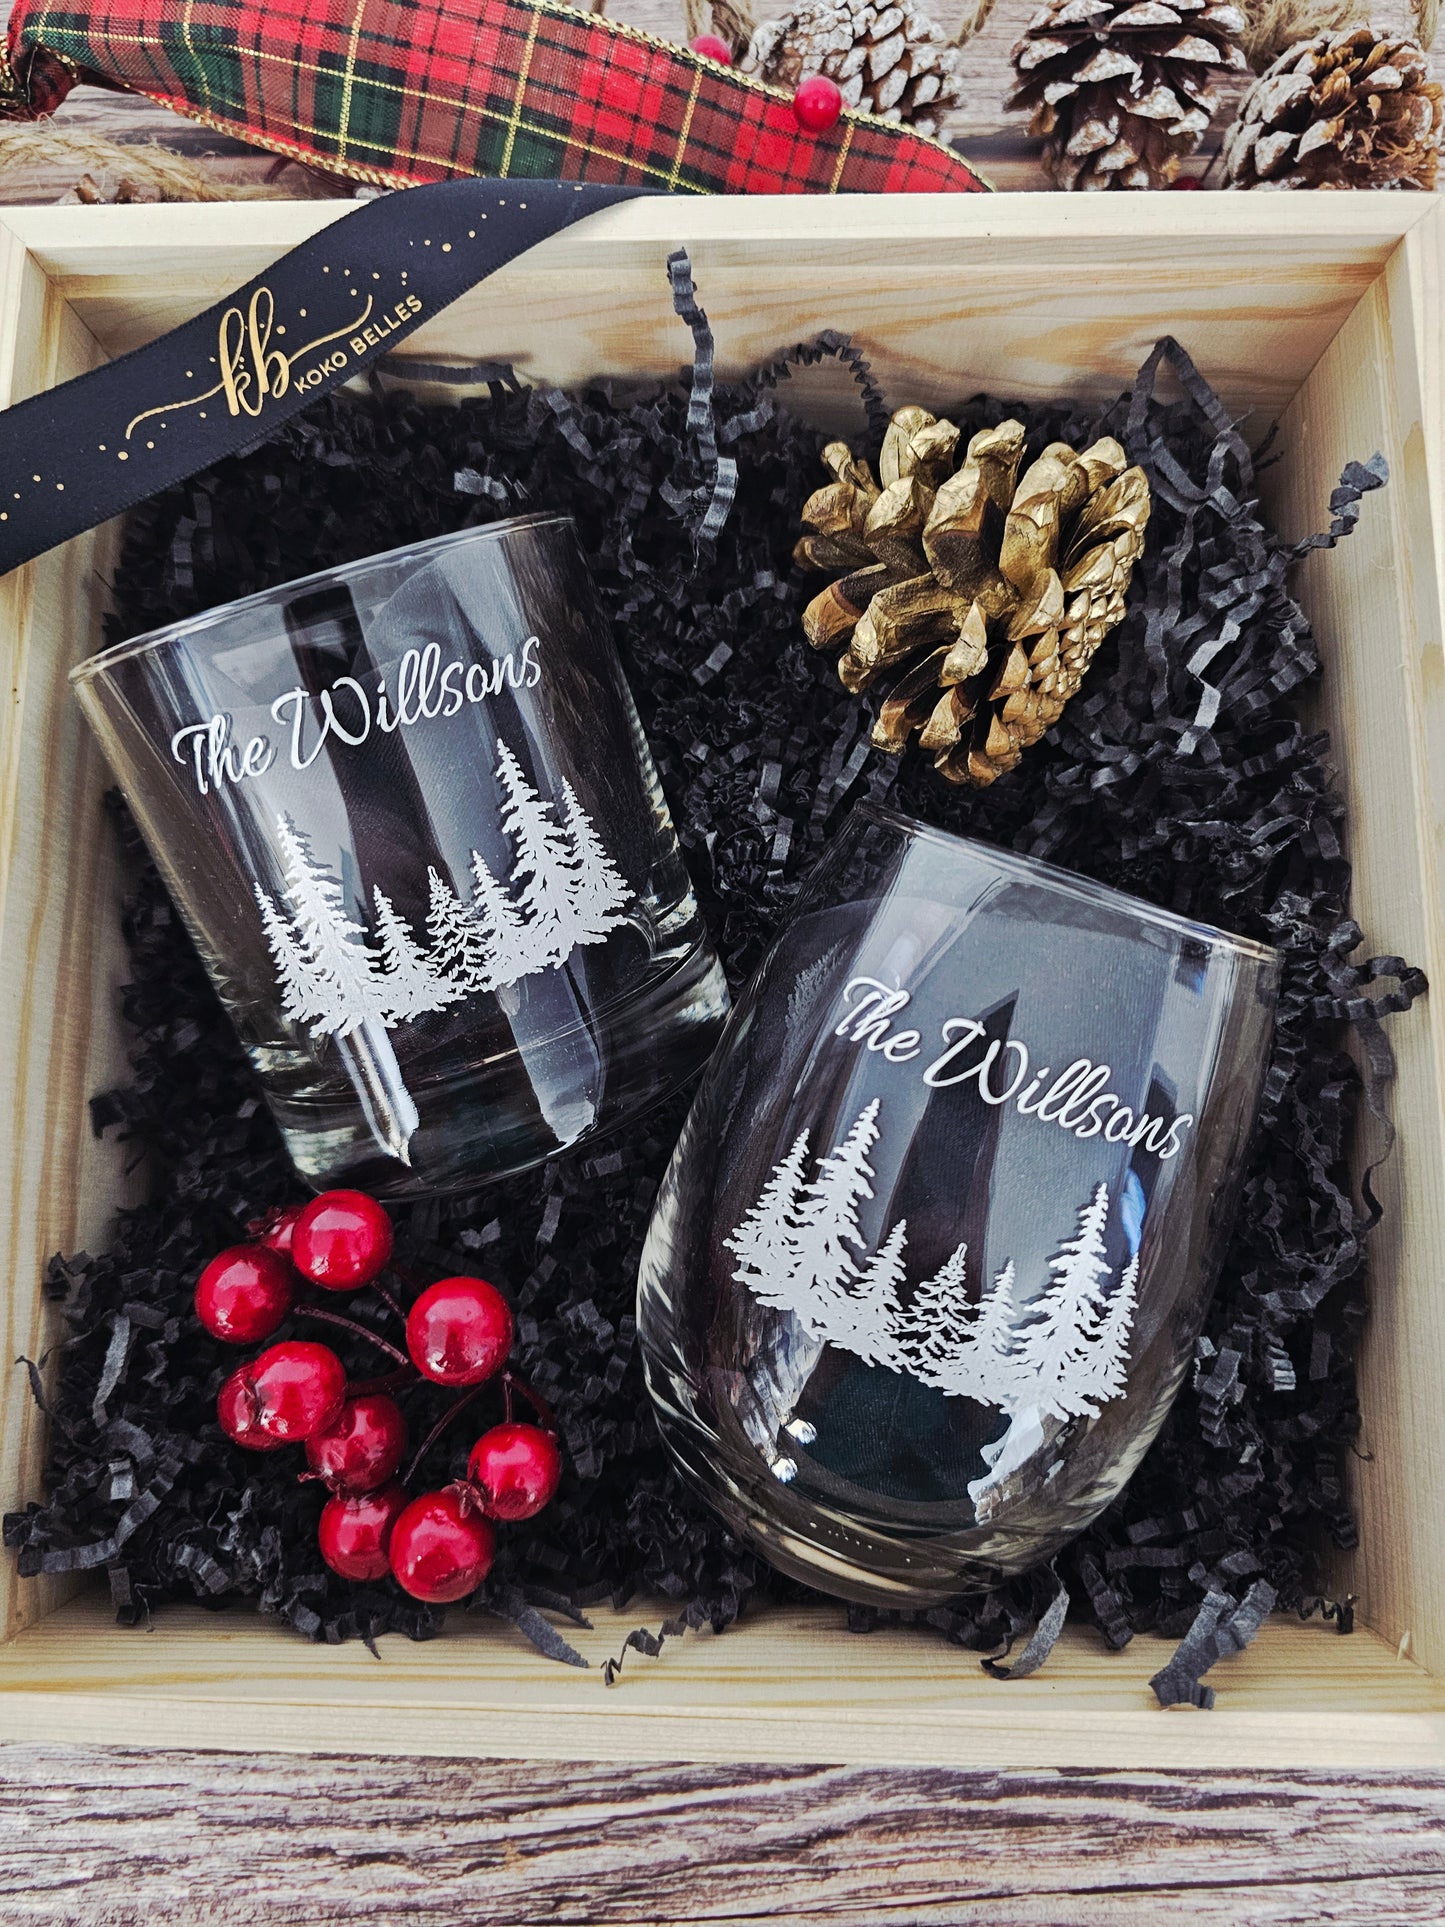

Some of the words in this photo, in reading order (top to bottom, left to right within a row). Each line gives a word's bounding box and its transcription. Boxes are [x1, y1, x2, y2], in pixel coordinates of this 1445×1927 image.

[293, 350, 348, 395] KOKO
[349, 294, 423, 356] BELLES
[171, 712, 274, 795] The
[271, 636, 542, 770] Willsons
[834, 976, 921, 1063] The
[922, 1017, 1195, 1160] Willsons
